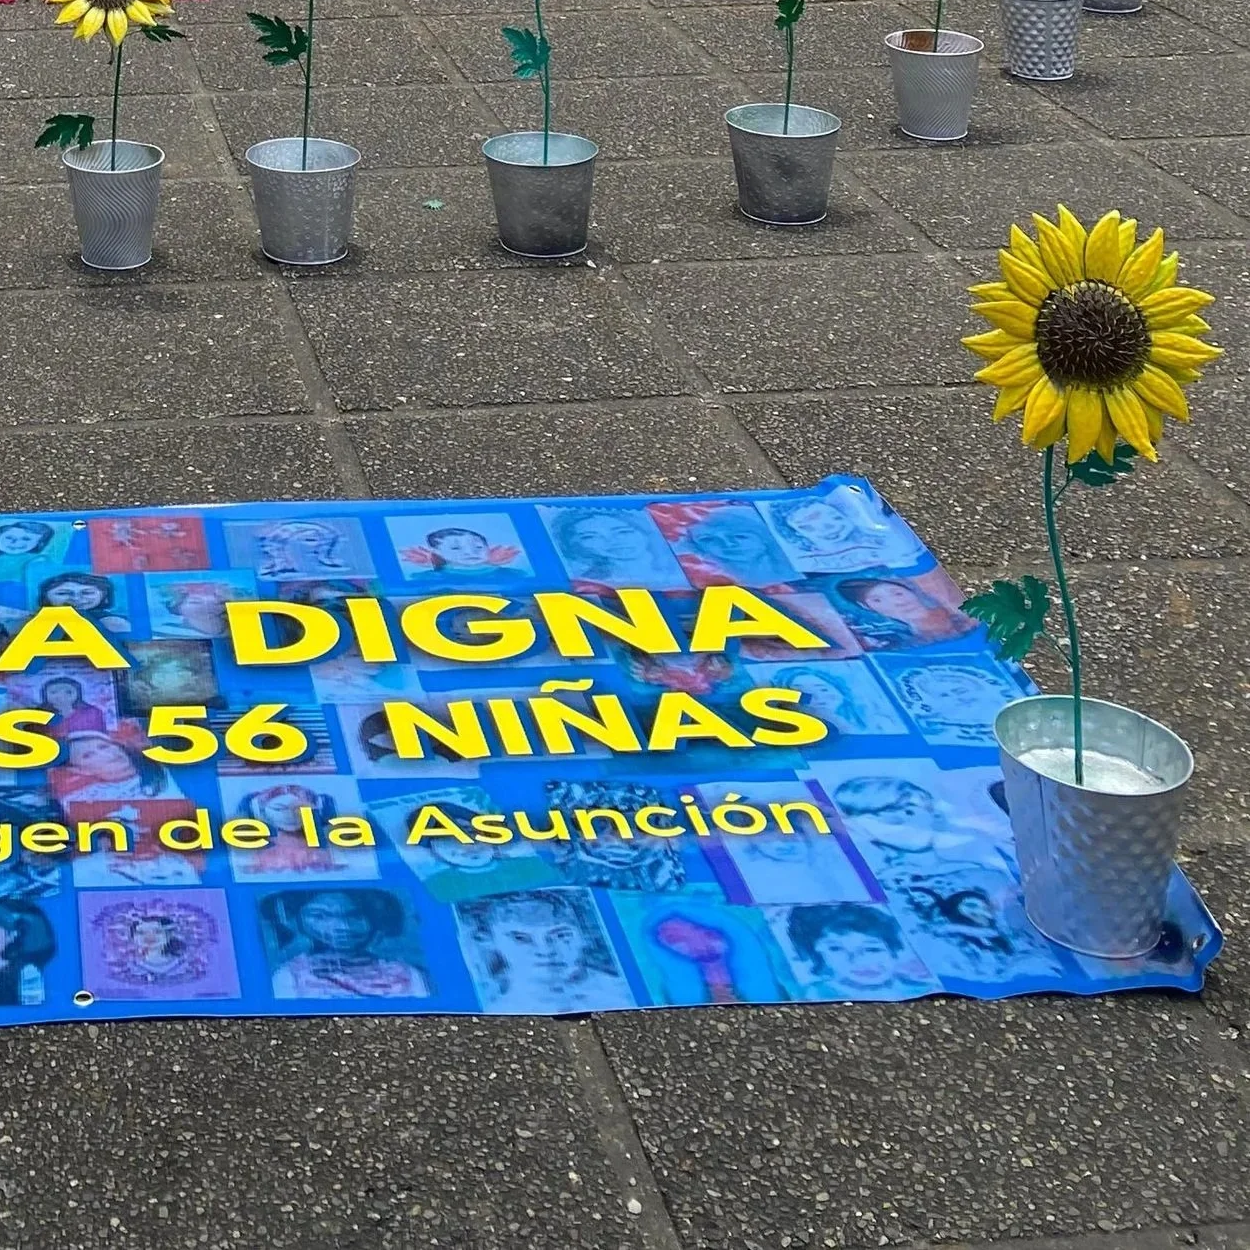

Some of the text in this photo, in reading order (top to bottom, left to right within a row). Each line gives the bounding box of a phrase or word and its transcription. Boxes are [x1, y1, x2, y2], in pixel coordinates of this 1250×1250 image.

[225, 584, 830, 665] DIGNA
[143, 704, 308, 765] 56
[383, 679, 829, 759] NIÑAS
[159, 810, 268, 850] de
[301, 807, 373, 846] la
[407, 793, 831, 845] Asunción
